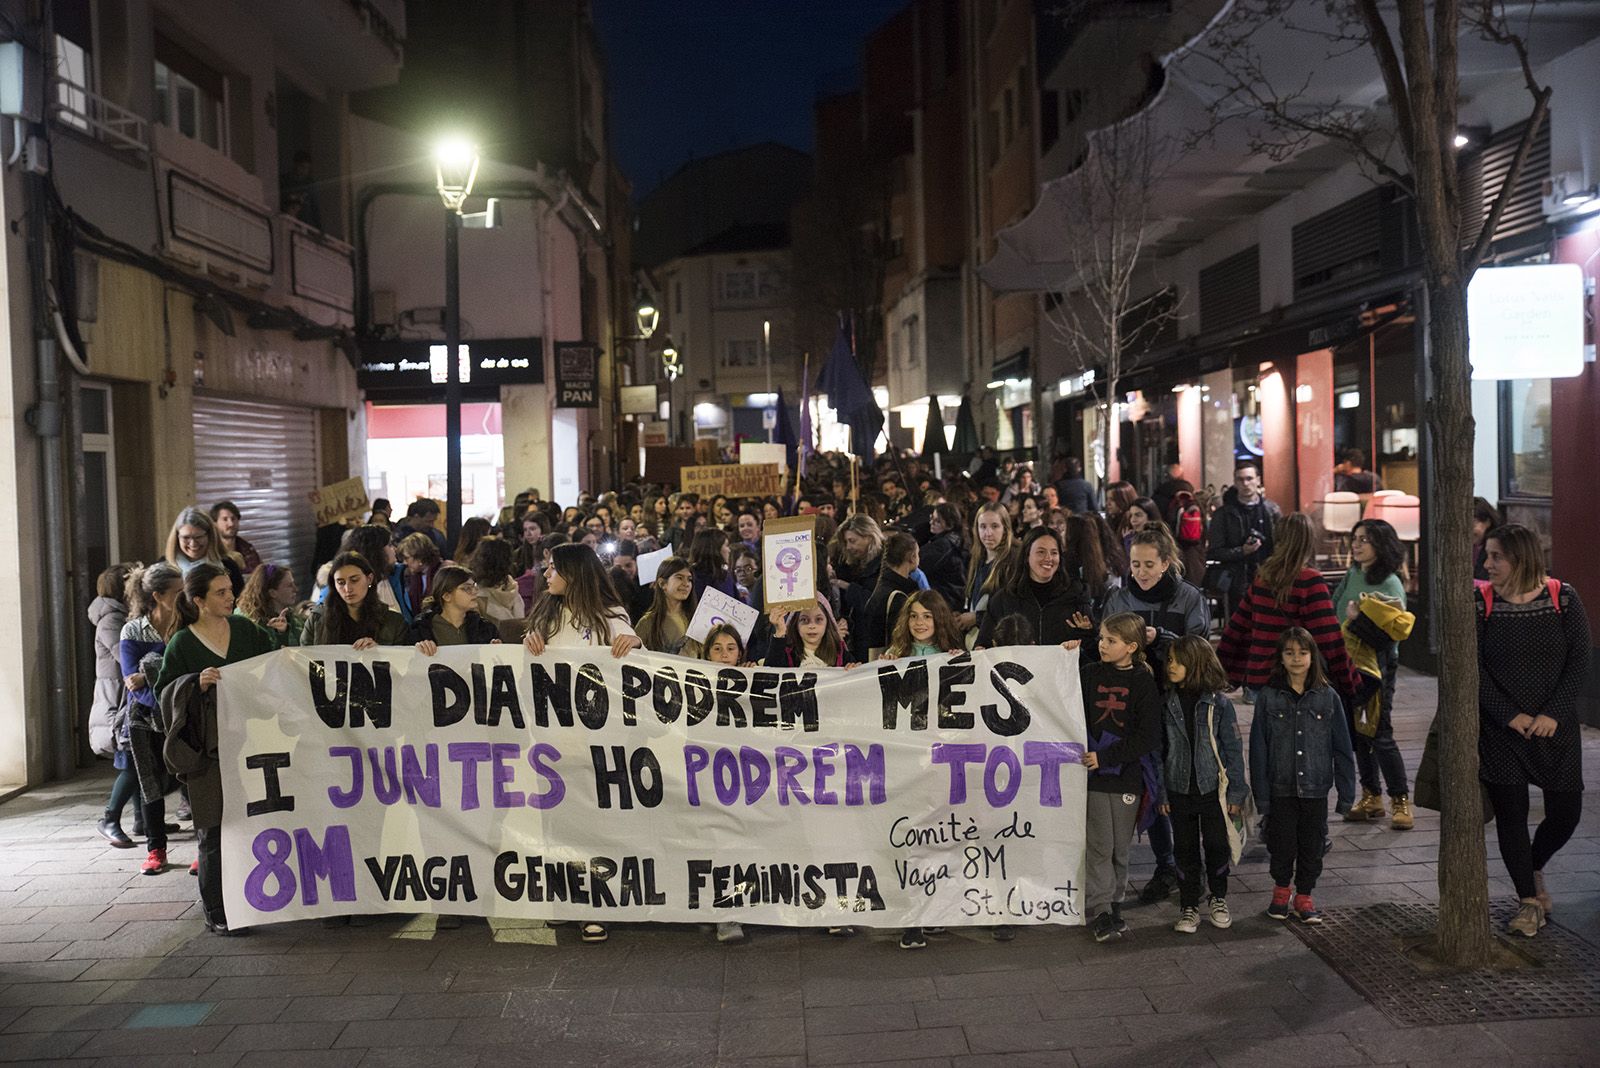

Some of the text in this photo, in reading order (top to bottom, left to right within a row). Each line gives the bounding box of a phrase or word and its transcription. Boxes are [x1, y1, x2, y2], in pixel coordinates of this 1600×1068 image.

[562, 389, 593, 402] PAN
[724, 466, 741, 478] CAS
[309, 651, 1035, 737] UN DIA NO PODREM MÉS
[246, 740, 1086, 818] I JUNTES HO PODREM TOT
[889, 811, 1036, 849] Comitè de
[244, 825, 358, 913] 8M
[364, 854, 479, 902] VAGA
[493, 851, 667, 908] GENERAL
[895, 846, 1007, 897] Vaga 8M
